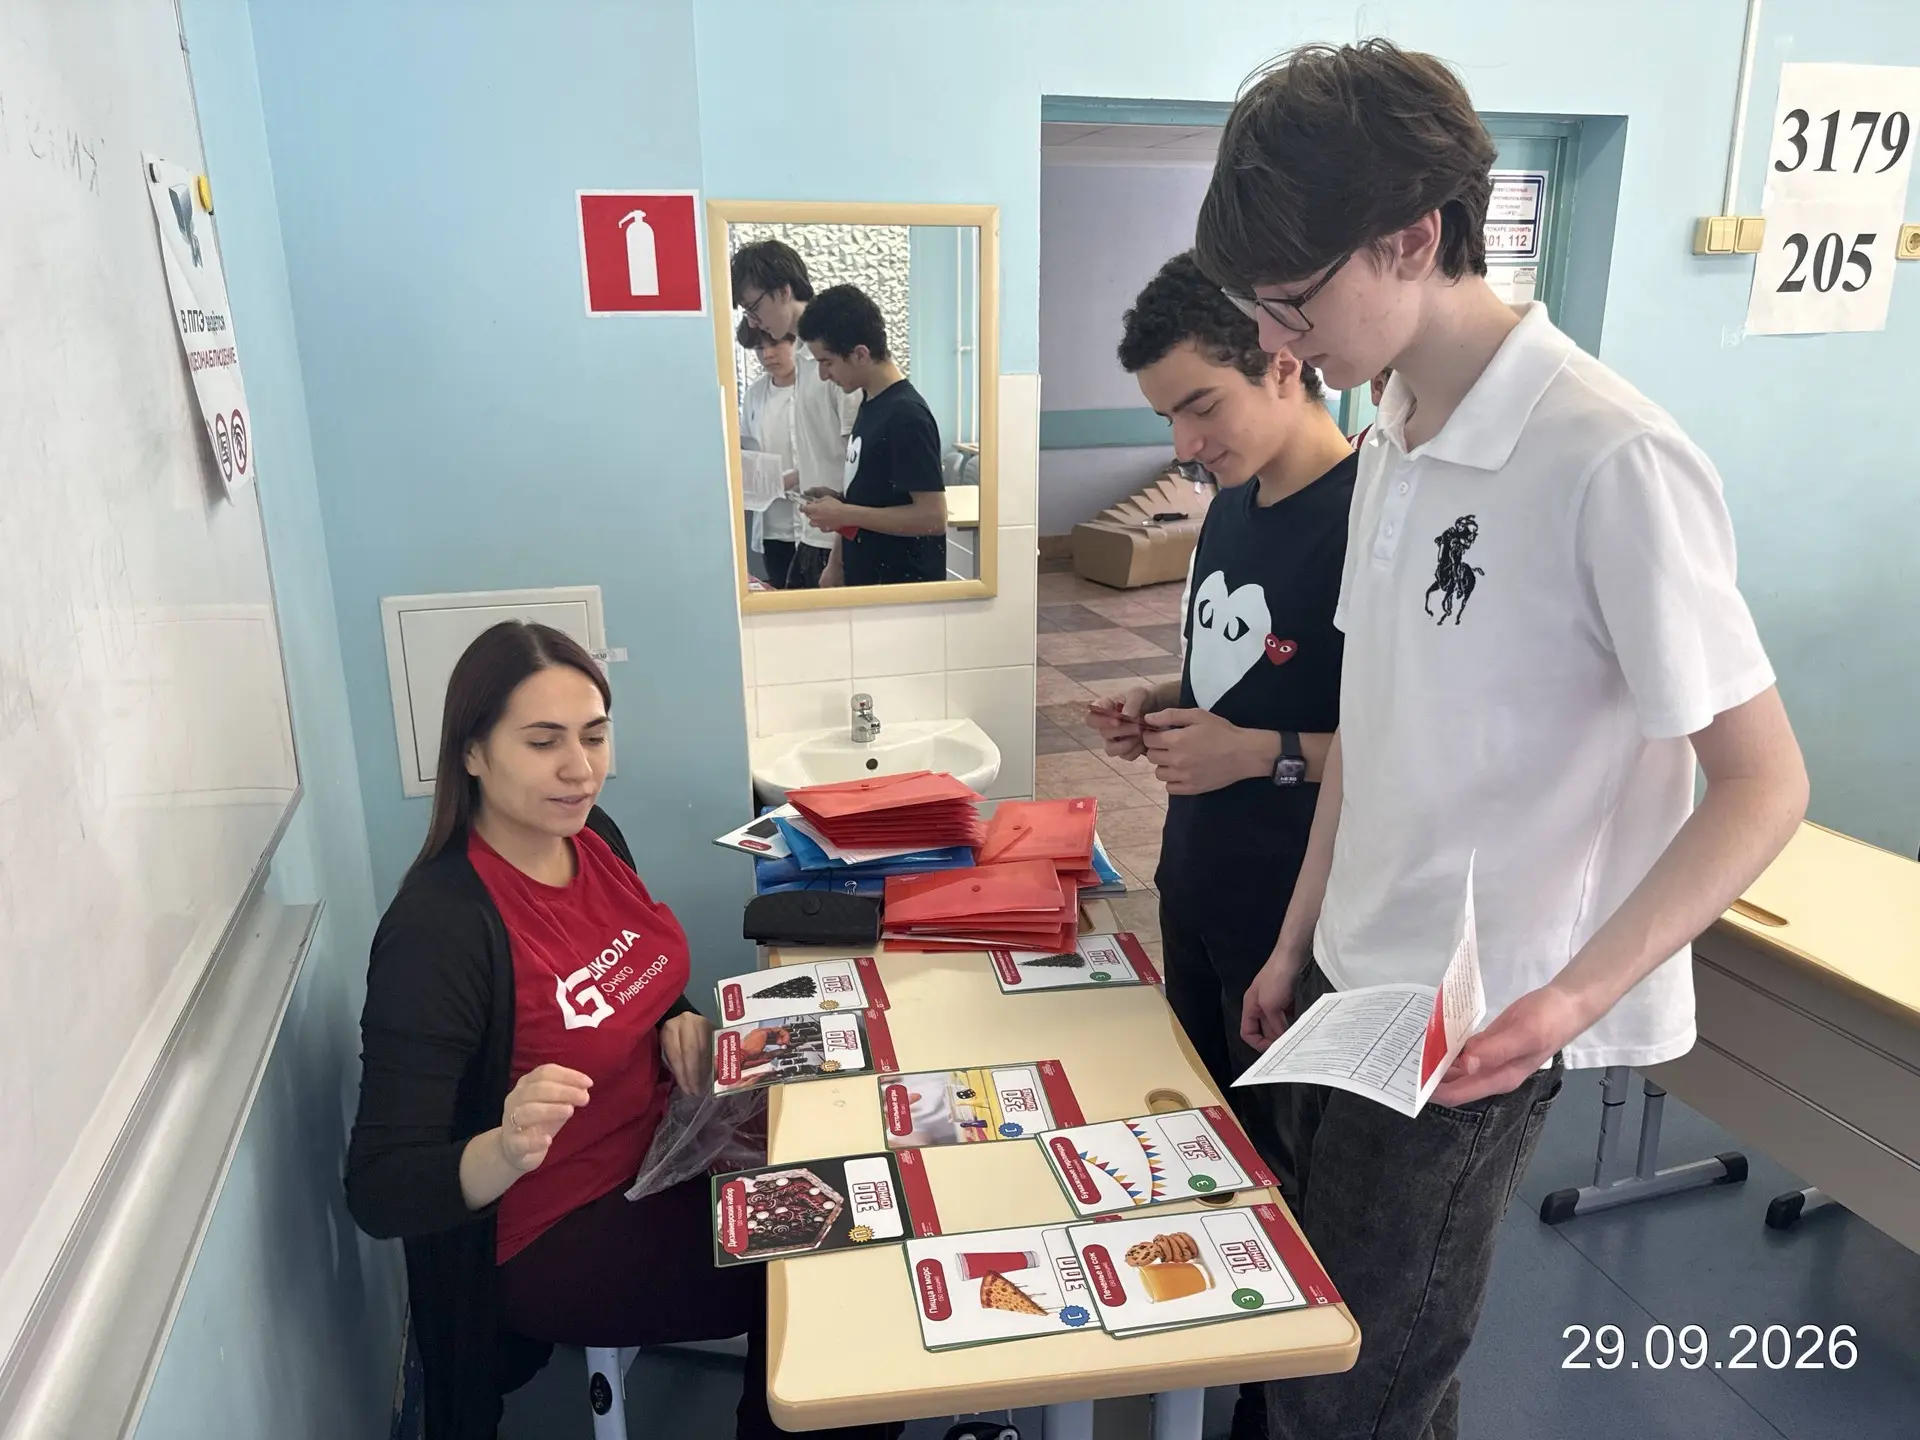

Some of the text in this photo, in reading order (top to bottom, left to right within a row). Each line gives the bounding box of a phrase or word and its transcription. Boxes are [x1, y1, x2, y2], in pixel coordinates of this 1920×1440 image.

[1774, 108, 1910, 173] 3179
[1509, 234, 1527, 247] 112
[1776, 232, 1877, 293] 205
[180, 309, 188, 333] В
[187, 309, 205, 333] ППЭ
[1087, 950, 1106, 966] 100
[615, 954, 669, 1005] Инвестора
[822, 976, 844, 994] 500
[825, 1031, 847, 1052] 700
[889, 1089, 902, 1132] Настольные игры
[1001, 1089, 1026, 1113] 250
[1055, 1142, 1073, 1169] гирлянды
[1177, 1142, 1207, 1160] 50
[1069, 1169, 1089, 1199] Бумажные
[852, 1182, 880, 1213] 300
[726, 1187, 738, 1247] Дизайнерский набор
[1089, 1252, 1099, 1265] сок
[1219, 1242, 1256, 1274] 100
[923, 1267, 932, 1285] морс
[1097, 1270, 1113, 1300] Печенье
[927, 1291, 939, 1314] Пицца
